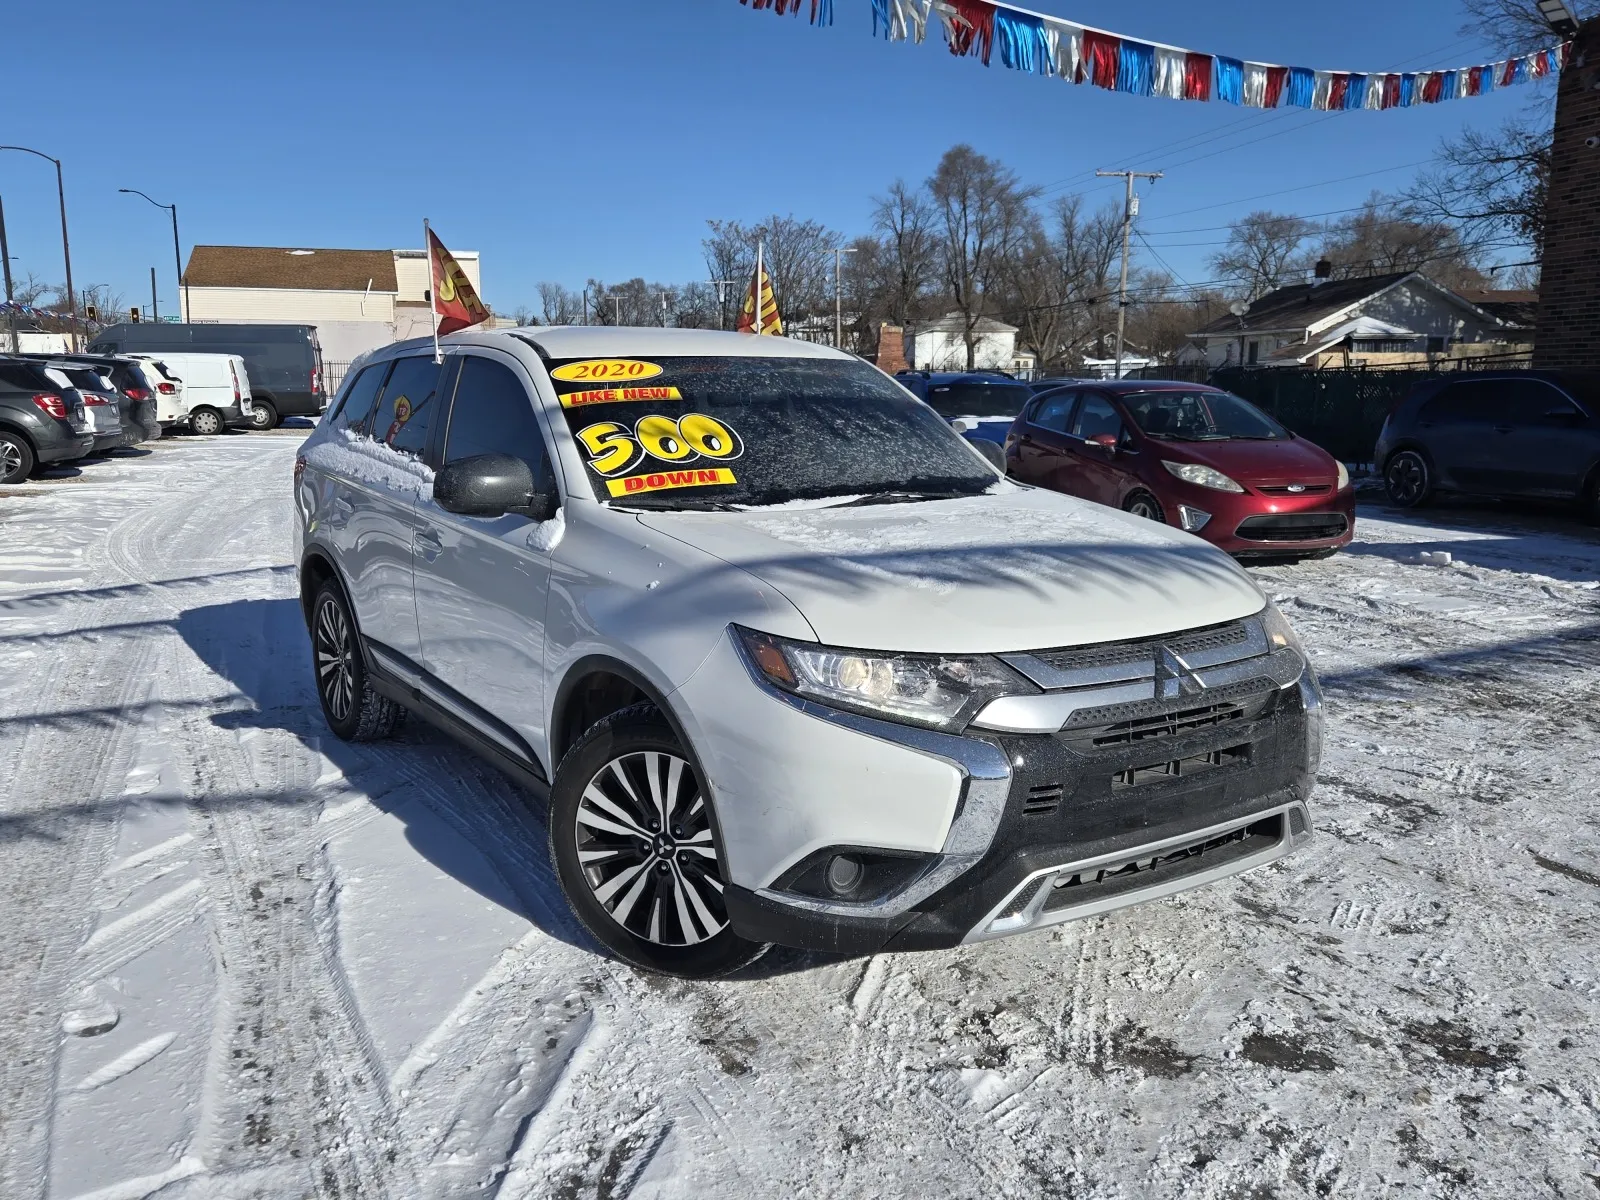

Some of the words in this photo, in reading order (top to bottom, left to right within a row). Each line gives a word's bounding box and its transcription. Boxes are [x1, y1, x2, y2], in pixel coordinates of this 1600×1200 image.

[573, 363, 645, 379] 2020
[570, 389, 618, 406] LIKE
[623, 388, 670, 401] NEW
[576, 413, 744, 477] 500
[624, 469, 720, 493] DOWN
